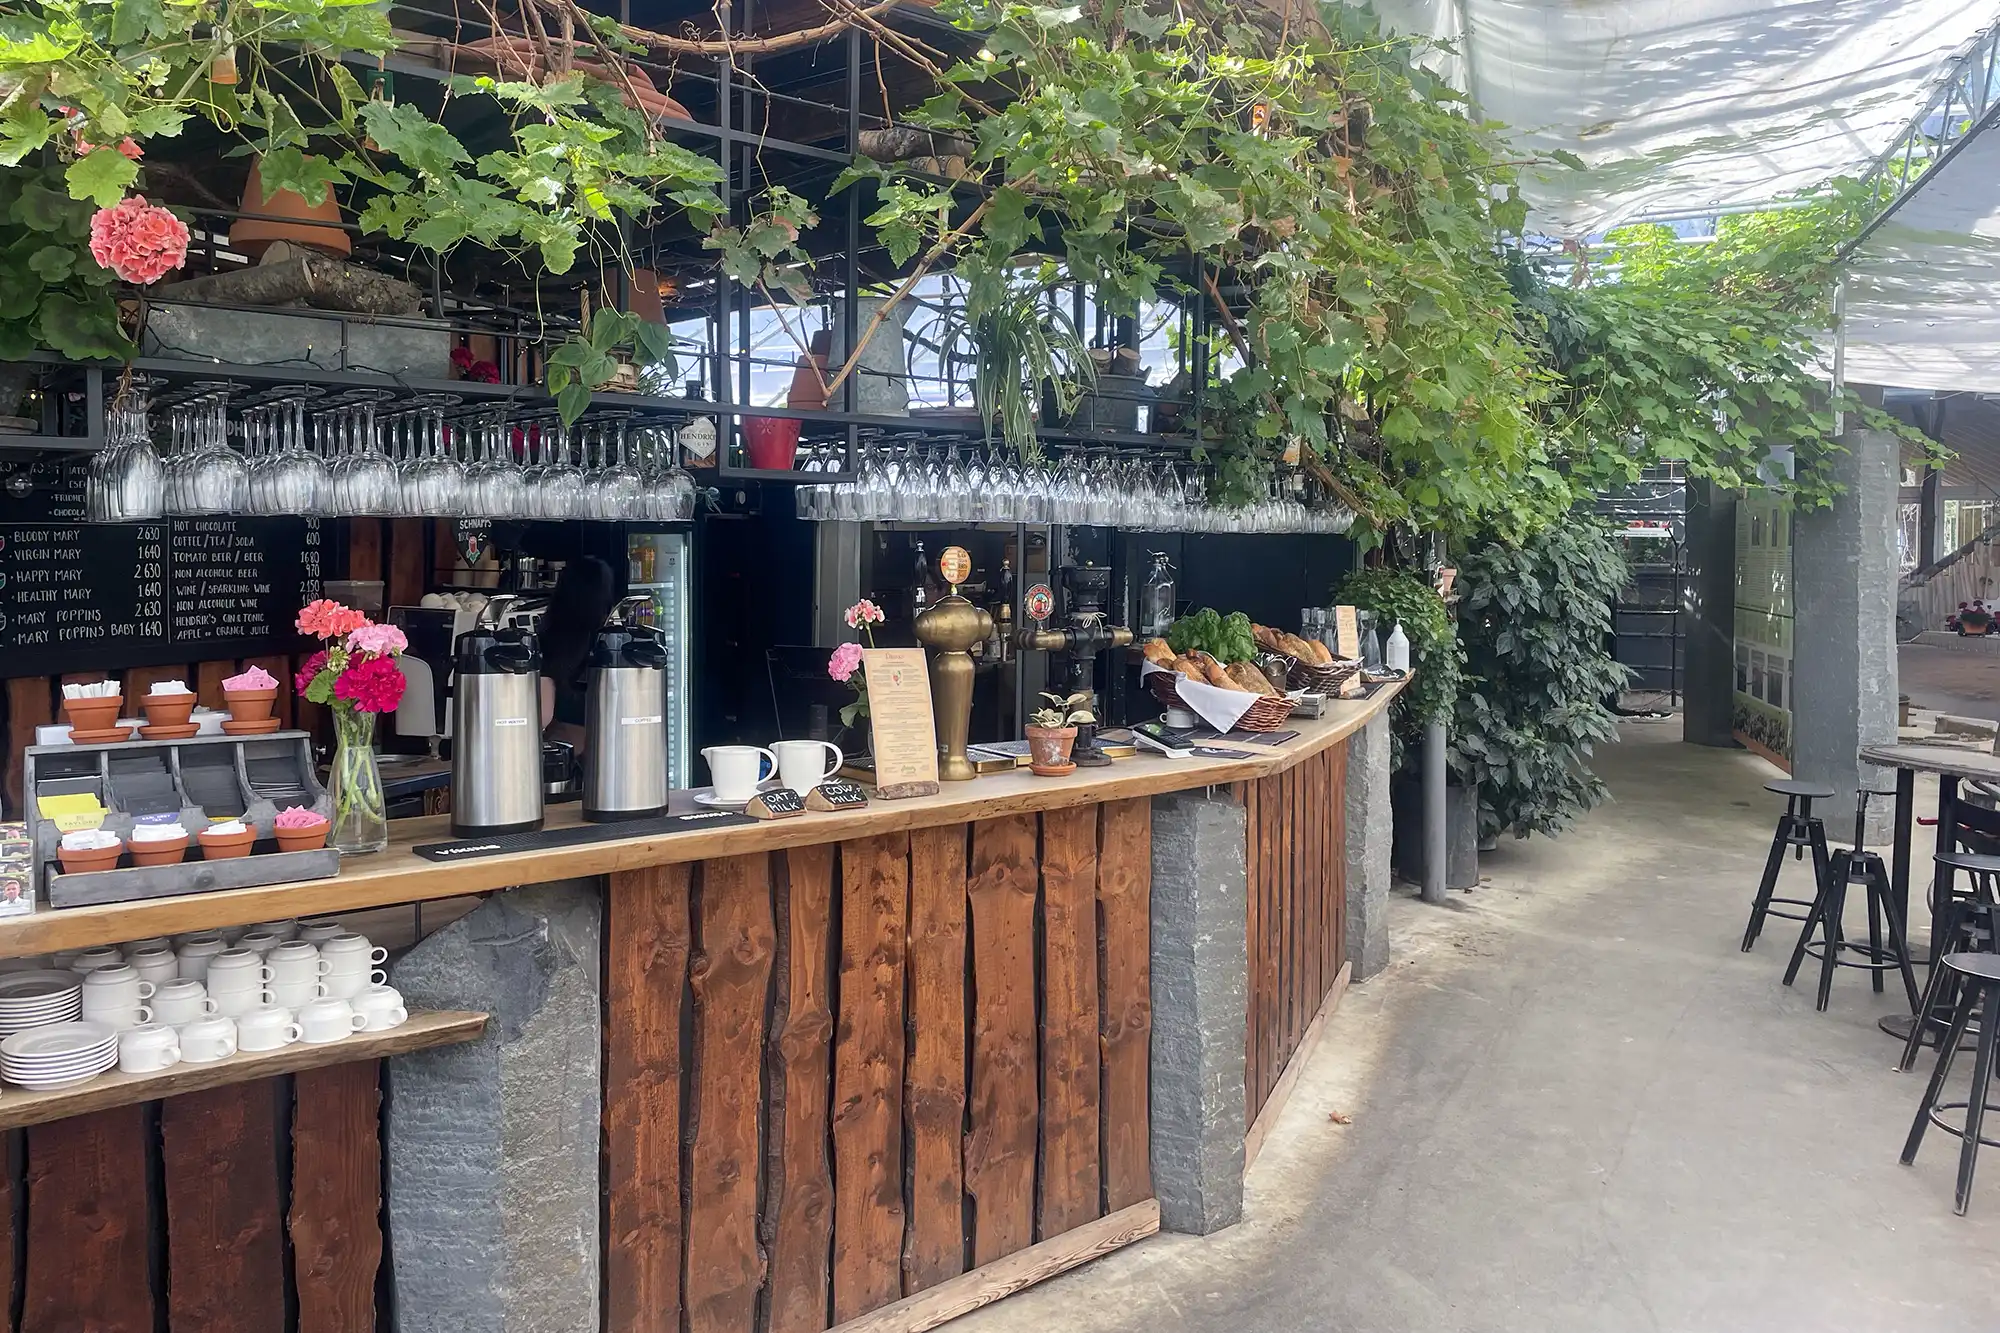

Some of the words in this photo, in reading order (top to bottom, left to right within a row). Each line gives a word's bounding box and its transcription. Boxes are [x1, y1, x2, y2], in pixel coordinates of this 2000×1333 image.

[53, 509, 86, 517] CHOCOLA
[174, 520, 190, 532] HOT
[195, 521, 237, 532] CHOCOLATE
[14, 531, 50, 542] BLOODY
[53, 530, 80, 541] MARY
[306, 531, 321, 546] 600
[14, 549, 50, 560] VIRGIN
[54, 549, 81, 560] MARY
[173, 551, 208, 563] TOMATO
[211, 551, 232, 562] BEER
[244, 552, 264, 562] BEER
[16, 570, 50, 582] HAPPY
[55, 569, 83, 581] MARY
[175, 569, 192, 579] NON
[195, 568, 234, 578] ALCOHOLIC
[238, 568, 258, 578] BEER
[306, 564, 320, 577] 970
[17, 589, 58, 602] HEALTHY
[64, 588, 92, 600] MARY
[176, 585, 197, 596] WINE
[208, 583, 250, 594] SPARKLING
[254, 583, 271, 594] WINE
[176, 601, 194, 612] NON
[198, 599, 236, 609] ALCOHOLIC
[240, 598, 258, 609] WINE
[18, 611, 46, 625] MARY
[56, 609, 102, 623] POPPINS
[18, 630, 50, 645] MARY
[59, 625, 105, 641] POPPINS
[110, 623, 136, 636] BABY
[176, 628, 202, 640] APPLE
[216, 625, 247, 636] ORANGE
[250, 624, 270, 635] JUICE
[825, 784, 853, 796] COW
[766, 791, 789, 803] OAT
[829, 794, 862, 804] MILK
[768, 802, 800, 812] MILK
